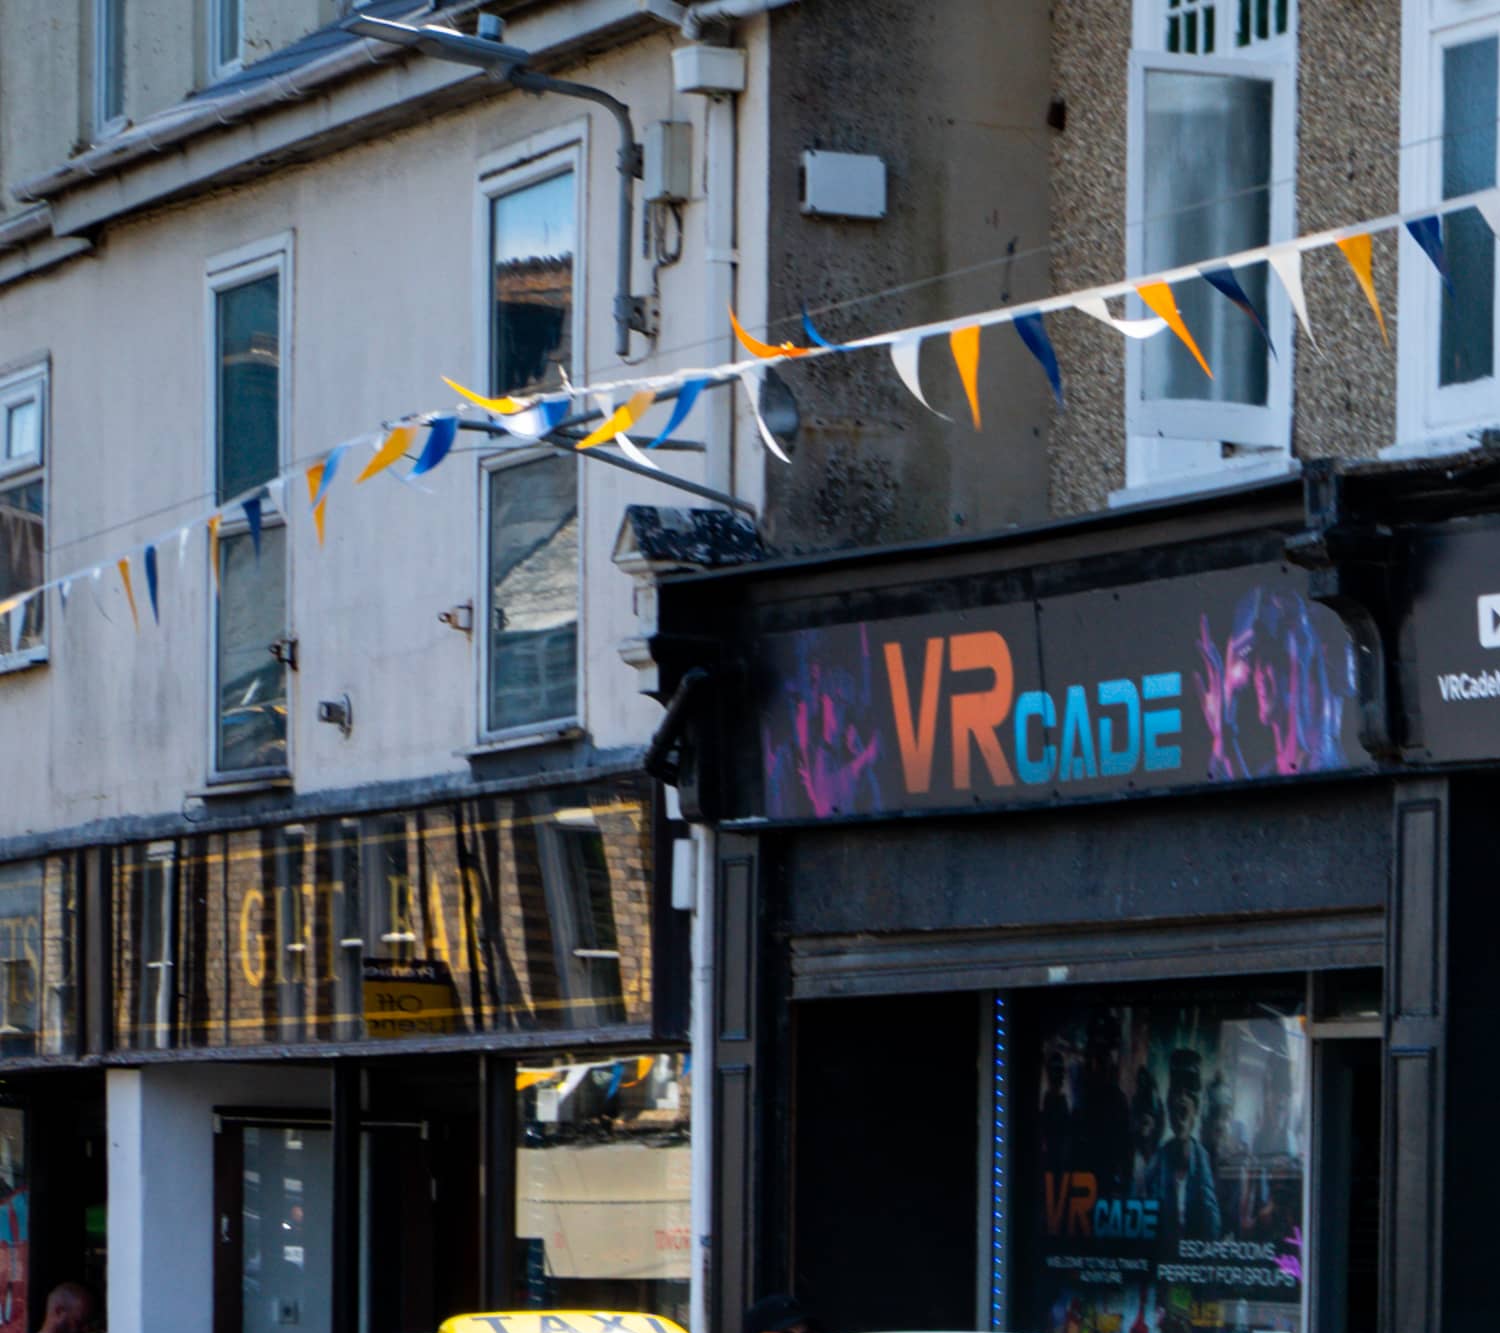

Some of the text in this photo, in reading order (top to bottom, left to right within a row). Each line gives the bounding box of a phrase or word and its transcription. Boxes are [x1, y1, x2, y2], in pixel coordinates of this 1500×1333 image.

[1157, 1263, 1297, 1288] PERFECT FOR GROUPS
